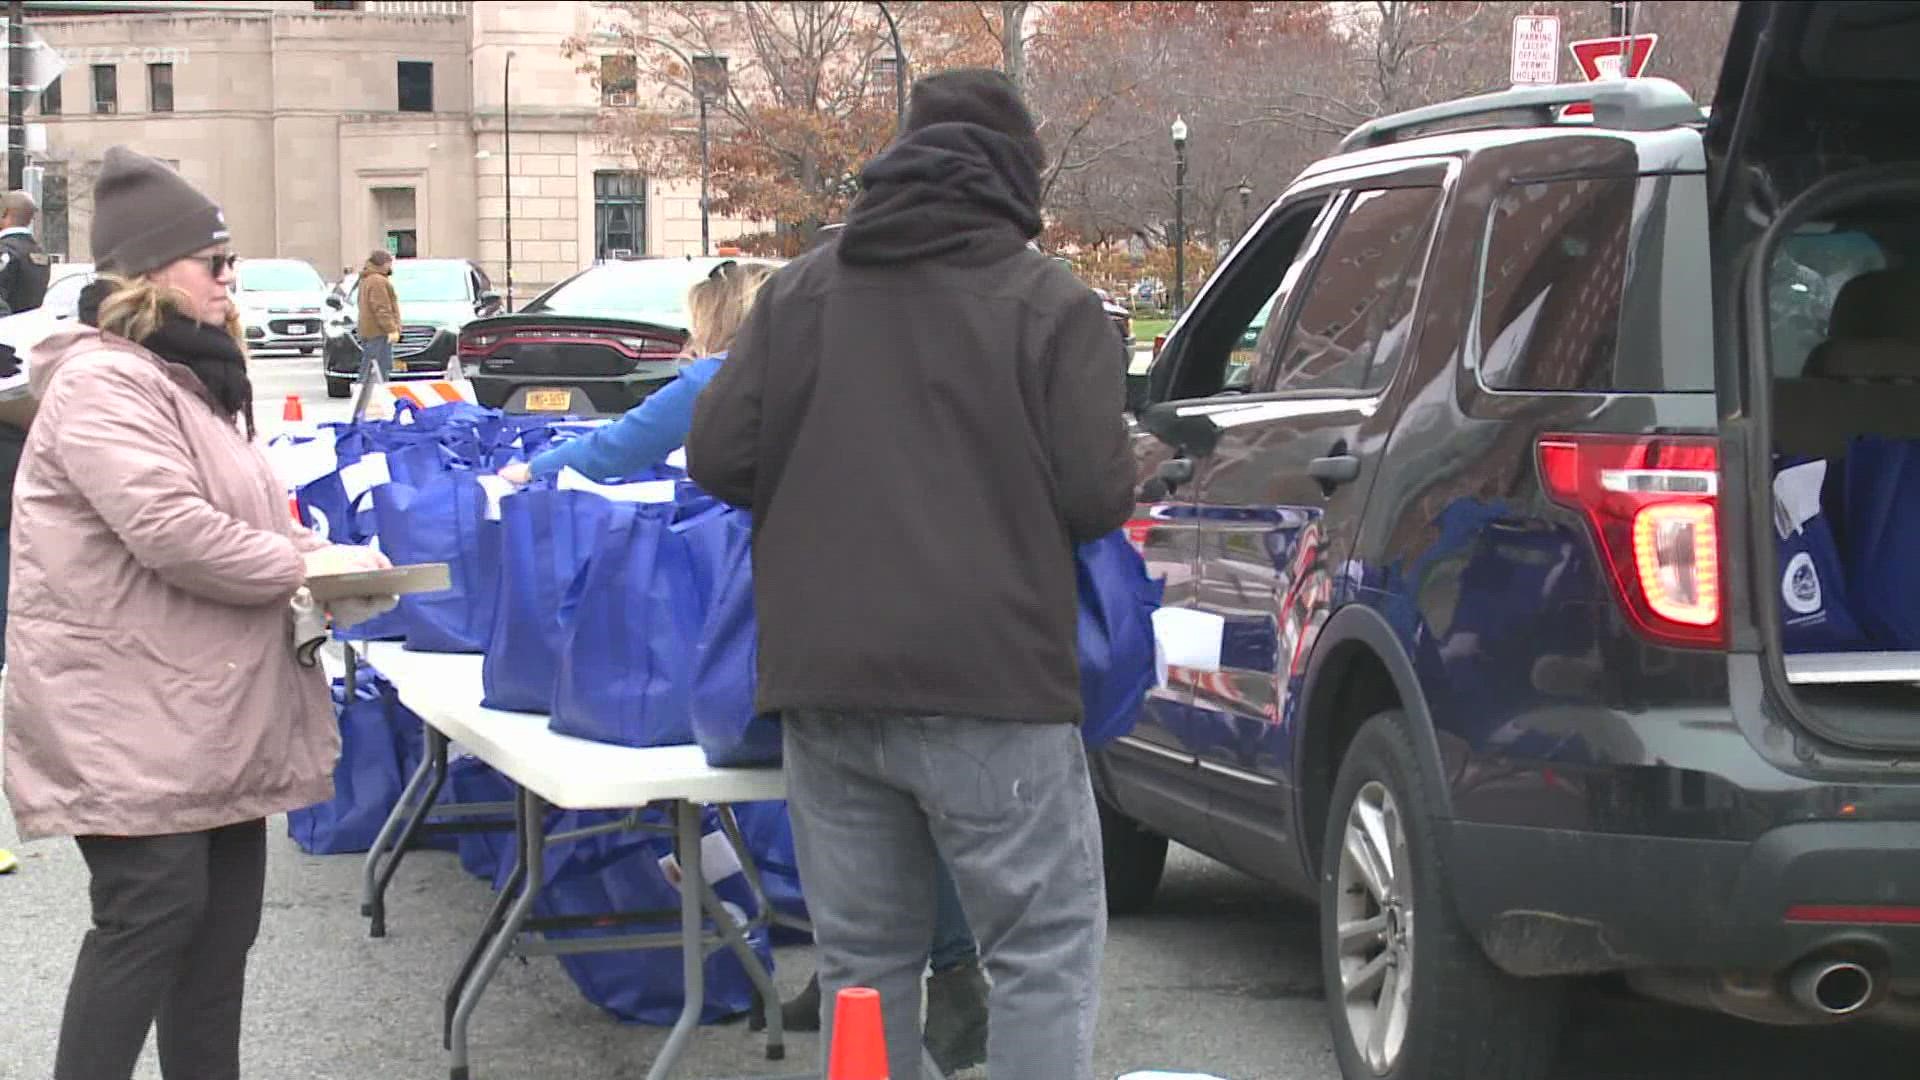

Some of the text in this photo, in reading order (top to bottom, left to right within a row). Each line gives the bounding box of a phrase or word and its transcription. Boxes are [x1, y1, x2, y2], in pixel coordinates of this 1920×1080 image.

[1530, 20, 1544, 32] NO
[1520, 32, 1552, 41] PARKING
[1518, 50, 1551, 60] OFFICIAL
[1521, 61, 1548, 69] PERMIT
[1516, 71, 1552, 80] HOLDERS
